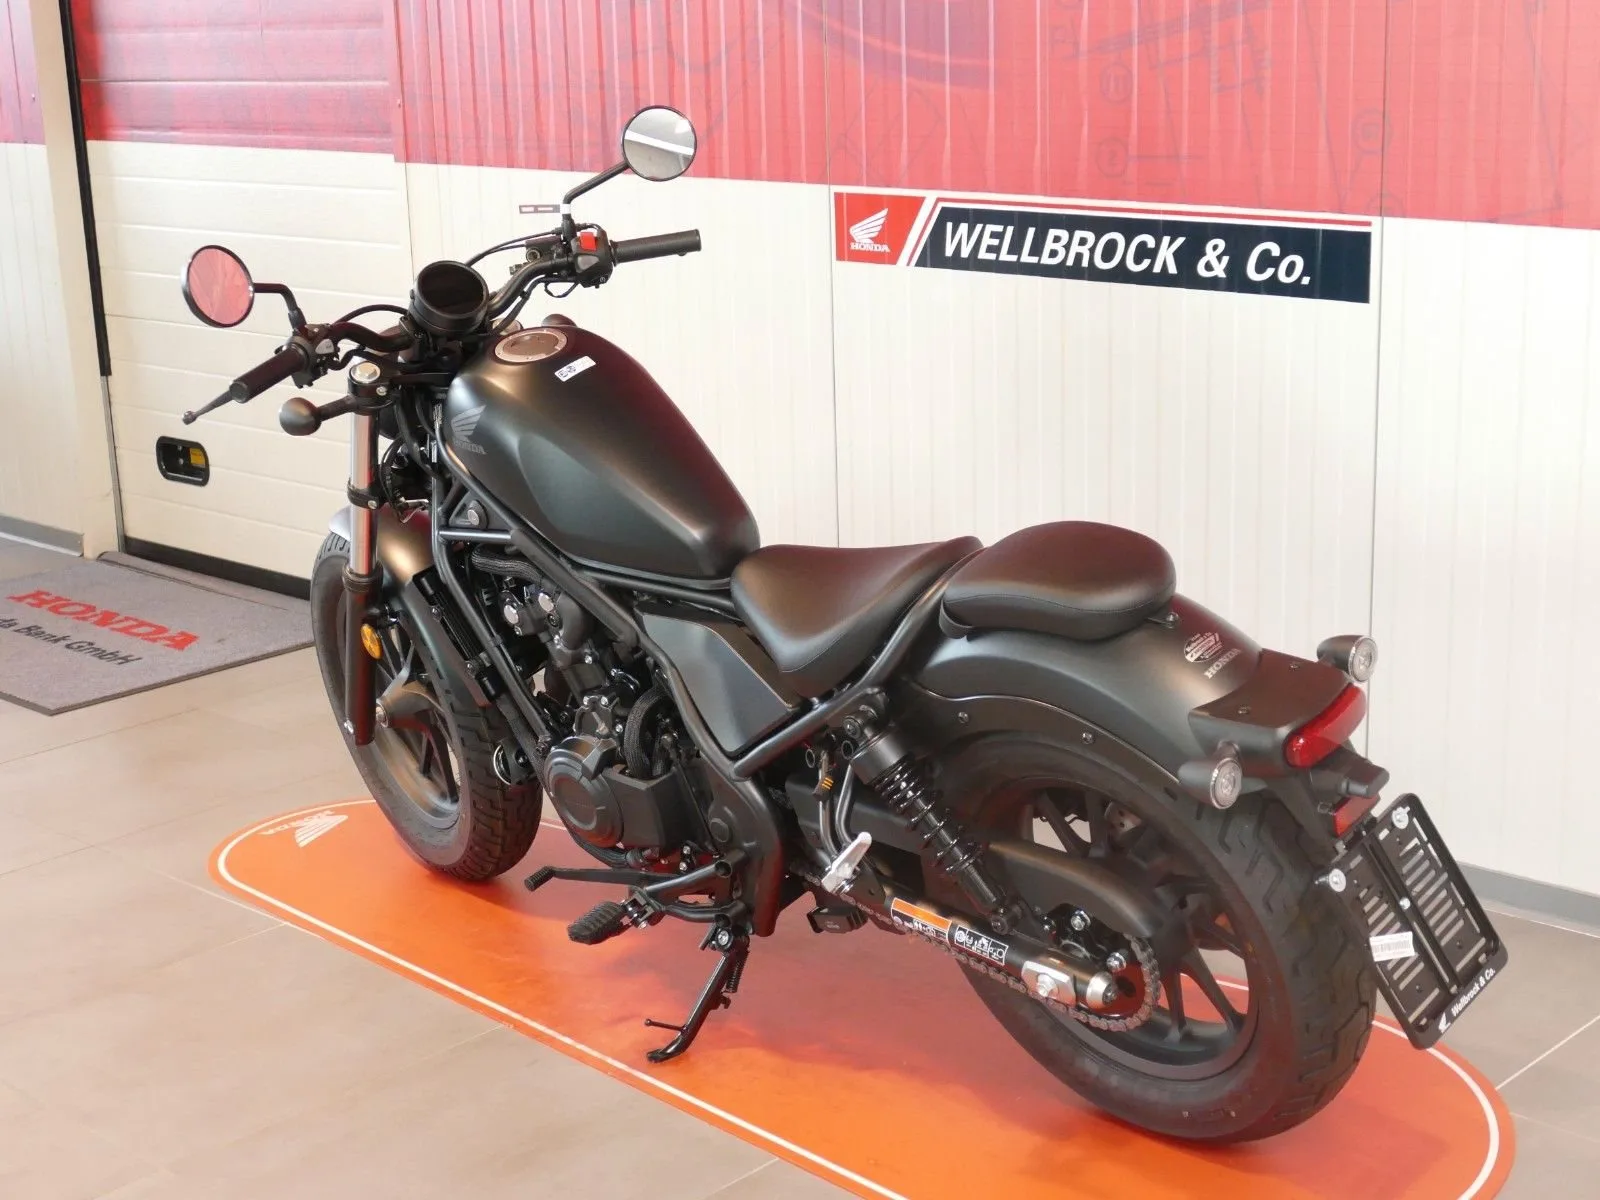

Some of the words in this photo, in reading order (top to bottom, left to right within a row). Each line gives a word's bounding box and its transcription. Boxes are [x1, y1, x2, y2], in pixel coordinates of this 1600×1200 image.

[850, 242, 891, 252] HONDA
[944, 222, 1186, 275] WELLBROCK
[1196, 238, 1230, 278] &
[1246, 241, 1311, 285] Co.
[6, 590, 199, 651] HONDA
[65, 640, 143, 666] GmbH
[1204, 648, 1241, 679] HONDA
